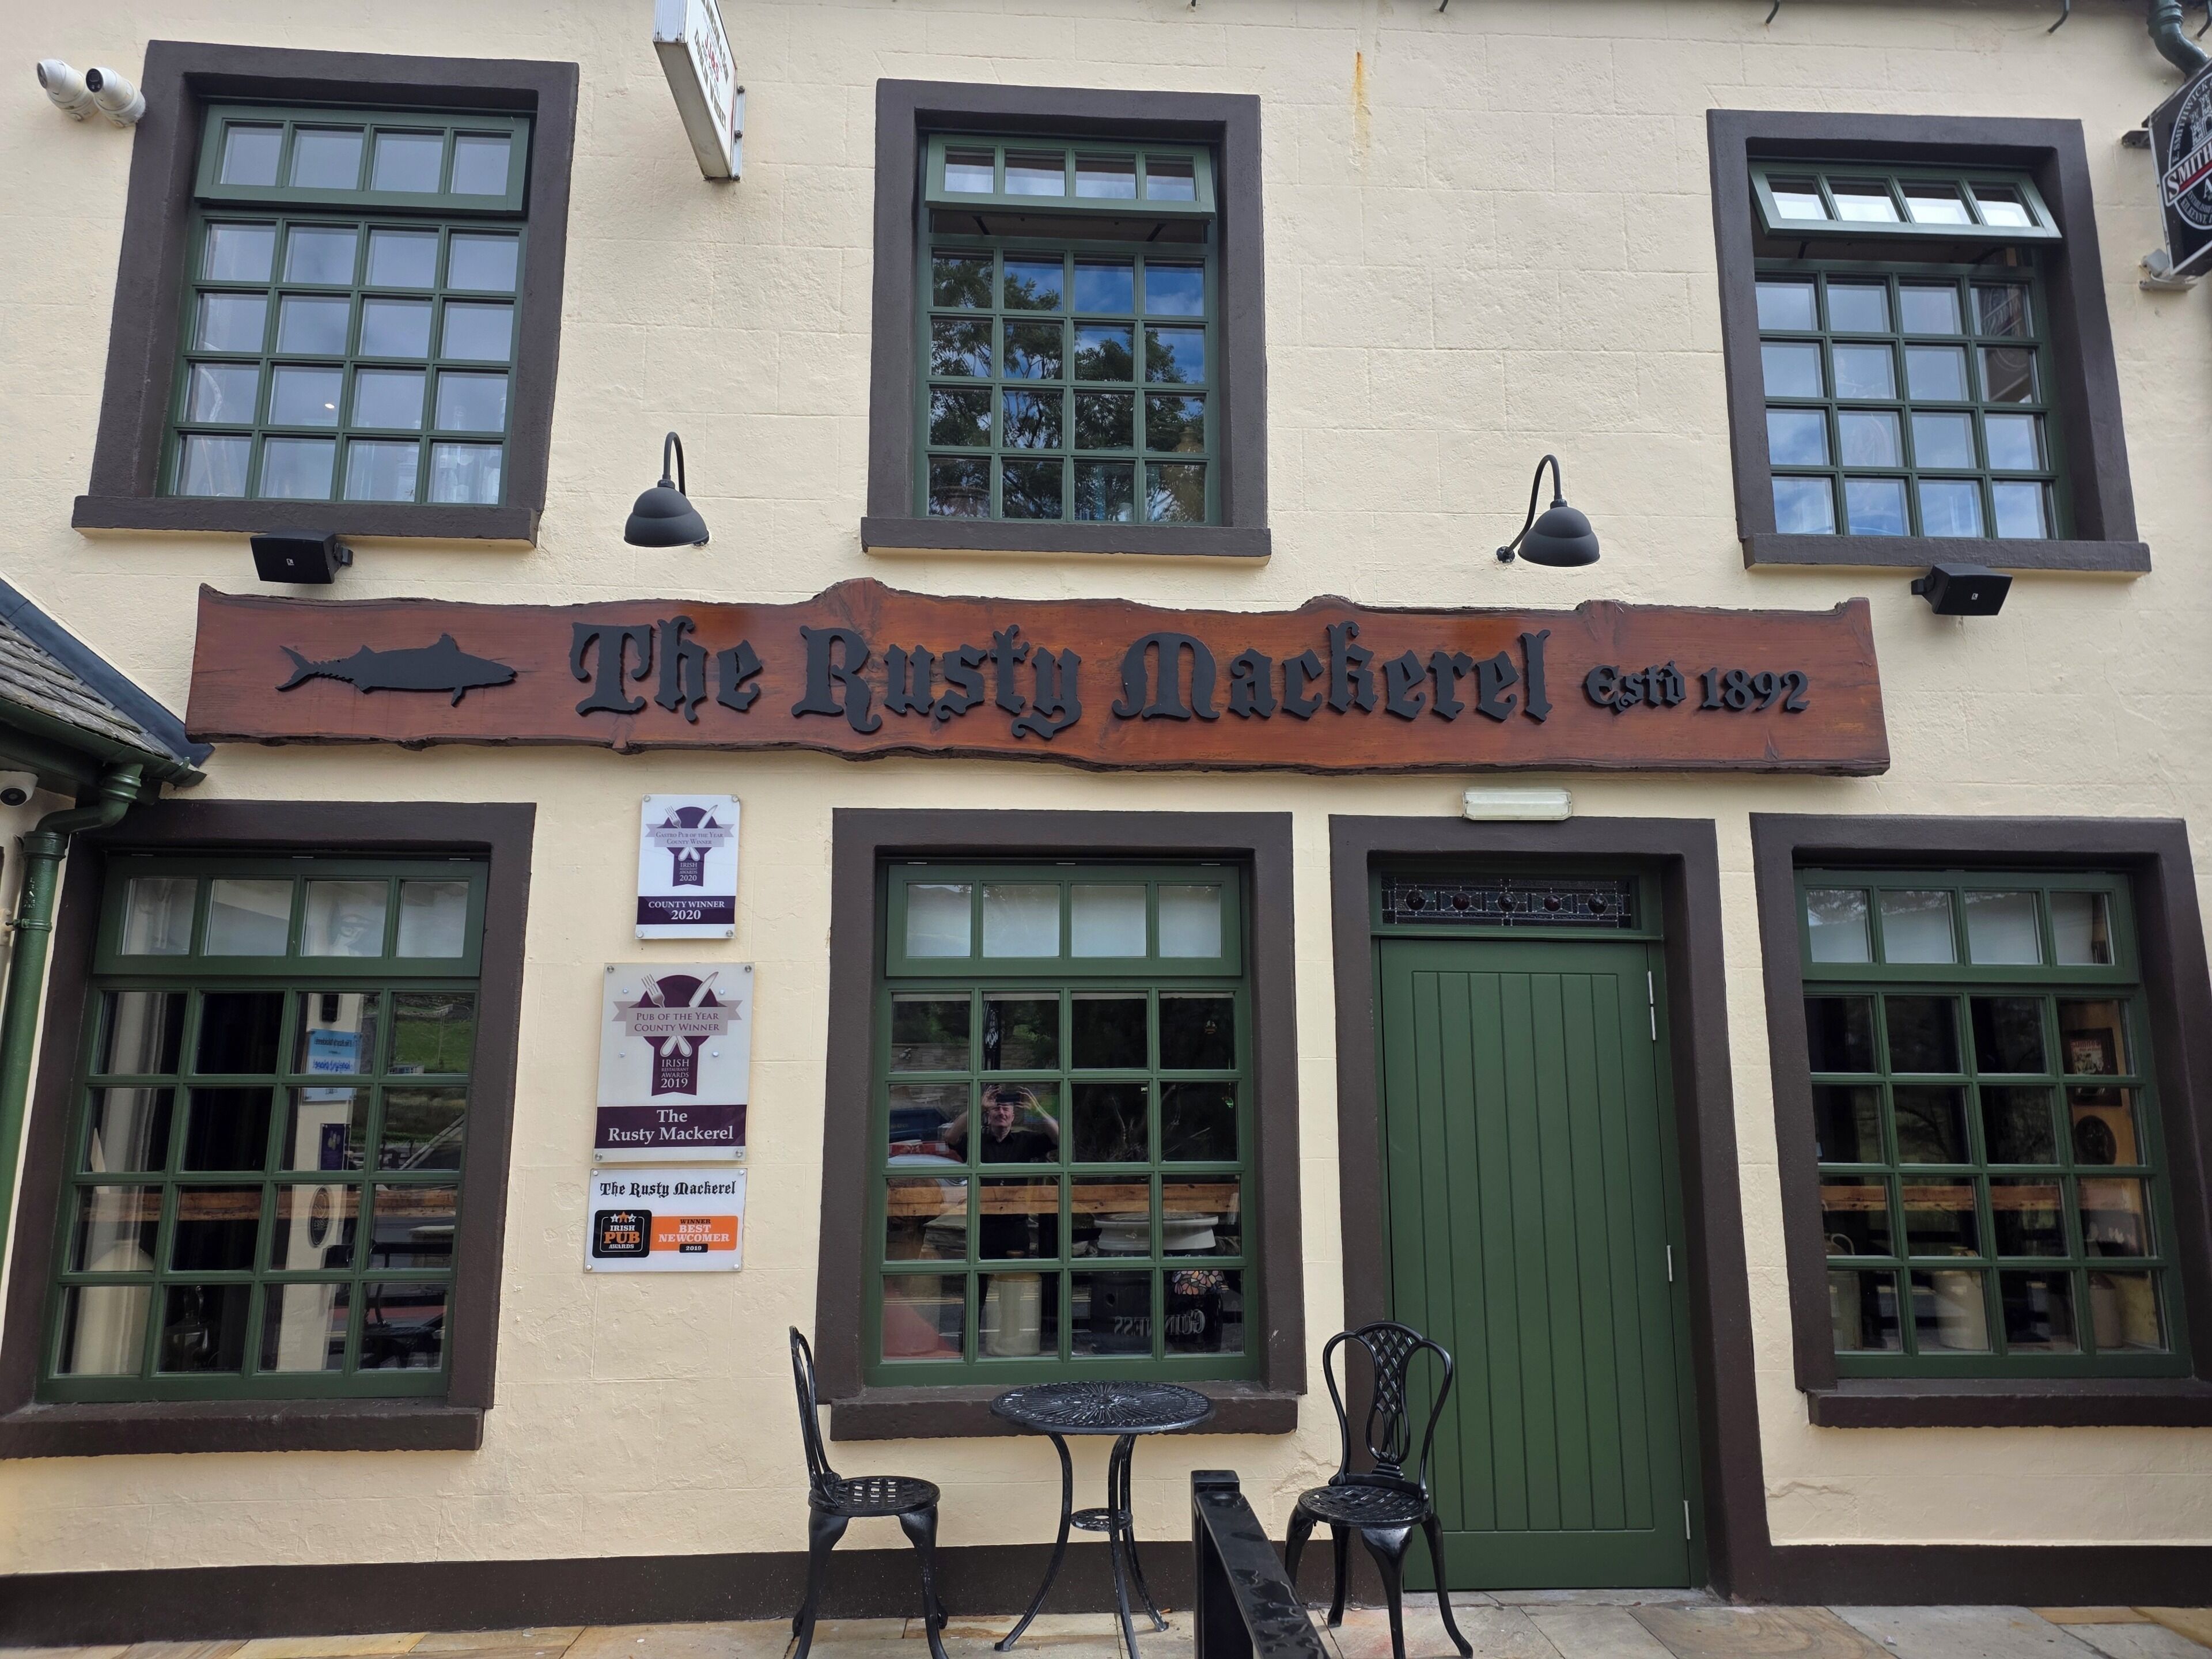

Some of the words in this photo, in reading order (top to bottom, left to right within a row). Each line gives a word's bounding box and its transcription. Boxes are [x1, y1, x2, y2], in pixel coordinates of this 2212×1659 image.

[694, 27, 708, 88] DUBLIN
[569, 615, 764, 724] The
[791, 624, 1082, 740] Rusty
[1112, 620, 1552, 722] Mackerel
[1698, 666, 1812, 713] 1892
[648, 900, 687, 908] COUNTY
[671, 910, 701, 920] 2020
[634, 1023, 676, 1032] COUNTY
[679, 1023, 719, 1031] WINNER
[662, 1059, 690, 1067] IRISH
[660, 1078, 688, 1088] 2019
[657, 1109, 688, 1123] The
[608, 1127, 655, 1145] Rusty
[659, 1126, 734, 1141] Mackerel
[600, 1181, 625, 1197] The
[628, 1181, 669, 1198] Rusty
[673, 1181, 737, 1196] Mackerel
[679, 1224, 711, 1233] BEST
[603, 1232, 641, 1244] PUB
[658, 1233, 729, 1243] NEWCOMER
